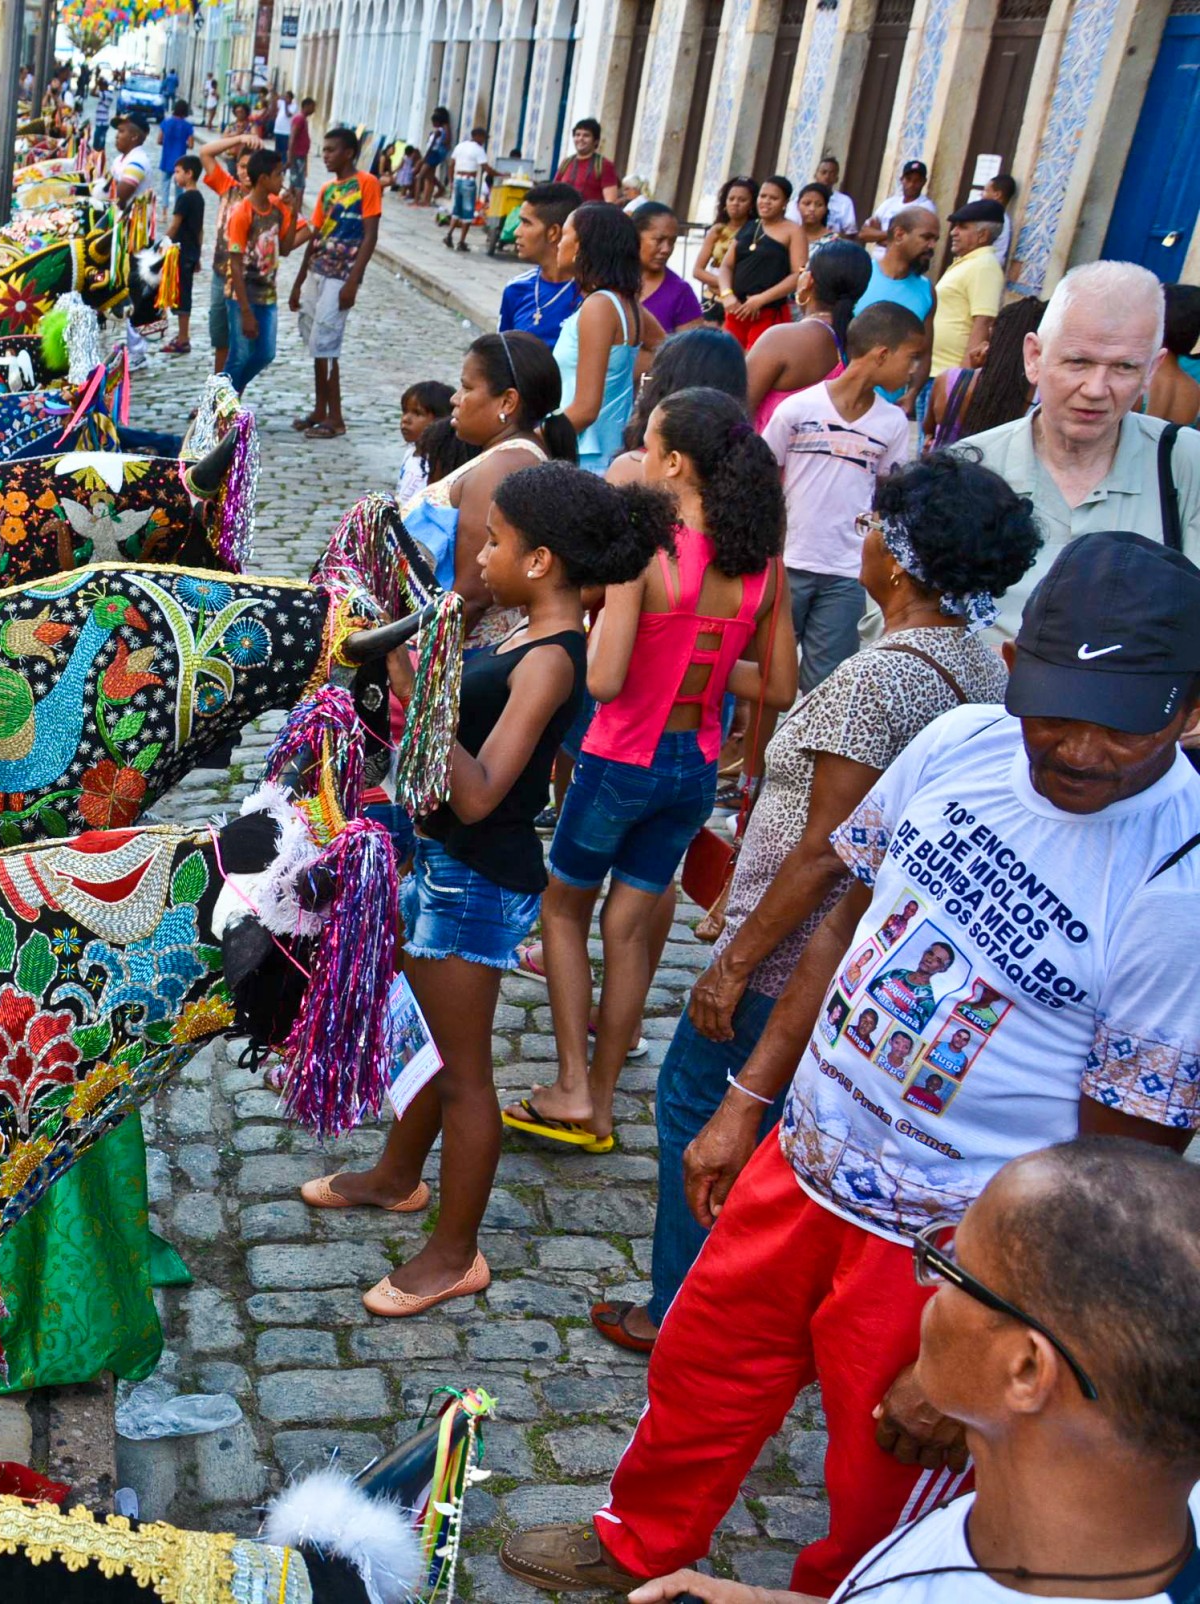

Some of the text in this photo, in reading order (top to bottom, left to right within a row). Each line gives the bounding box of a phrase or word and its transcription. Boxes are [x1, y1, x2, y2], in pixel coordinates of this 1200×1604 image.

[889, 839, 1067, 1009] DE TODOS OS SOTAQUES
[897, 820, 920, 847] DE
[914, 839, 985, 911] BUMBA
[980, 904, 1035, 960] MEU
[938, 830, 1050, 941] DE MIOLOS
[968, 824, 1089, 944] ENCONTRO
[881, 976, 925, 1014] Zequinha
[819, 1059, 854, 1092] 2015
[852, 1087, 893, 1127] Praia
[929, 1049, 962, 1073] Hugo
